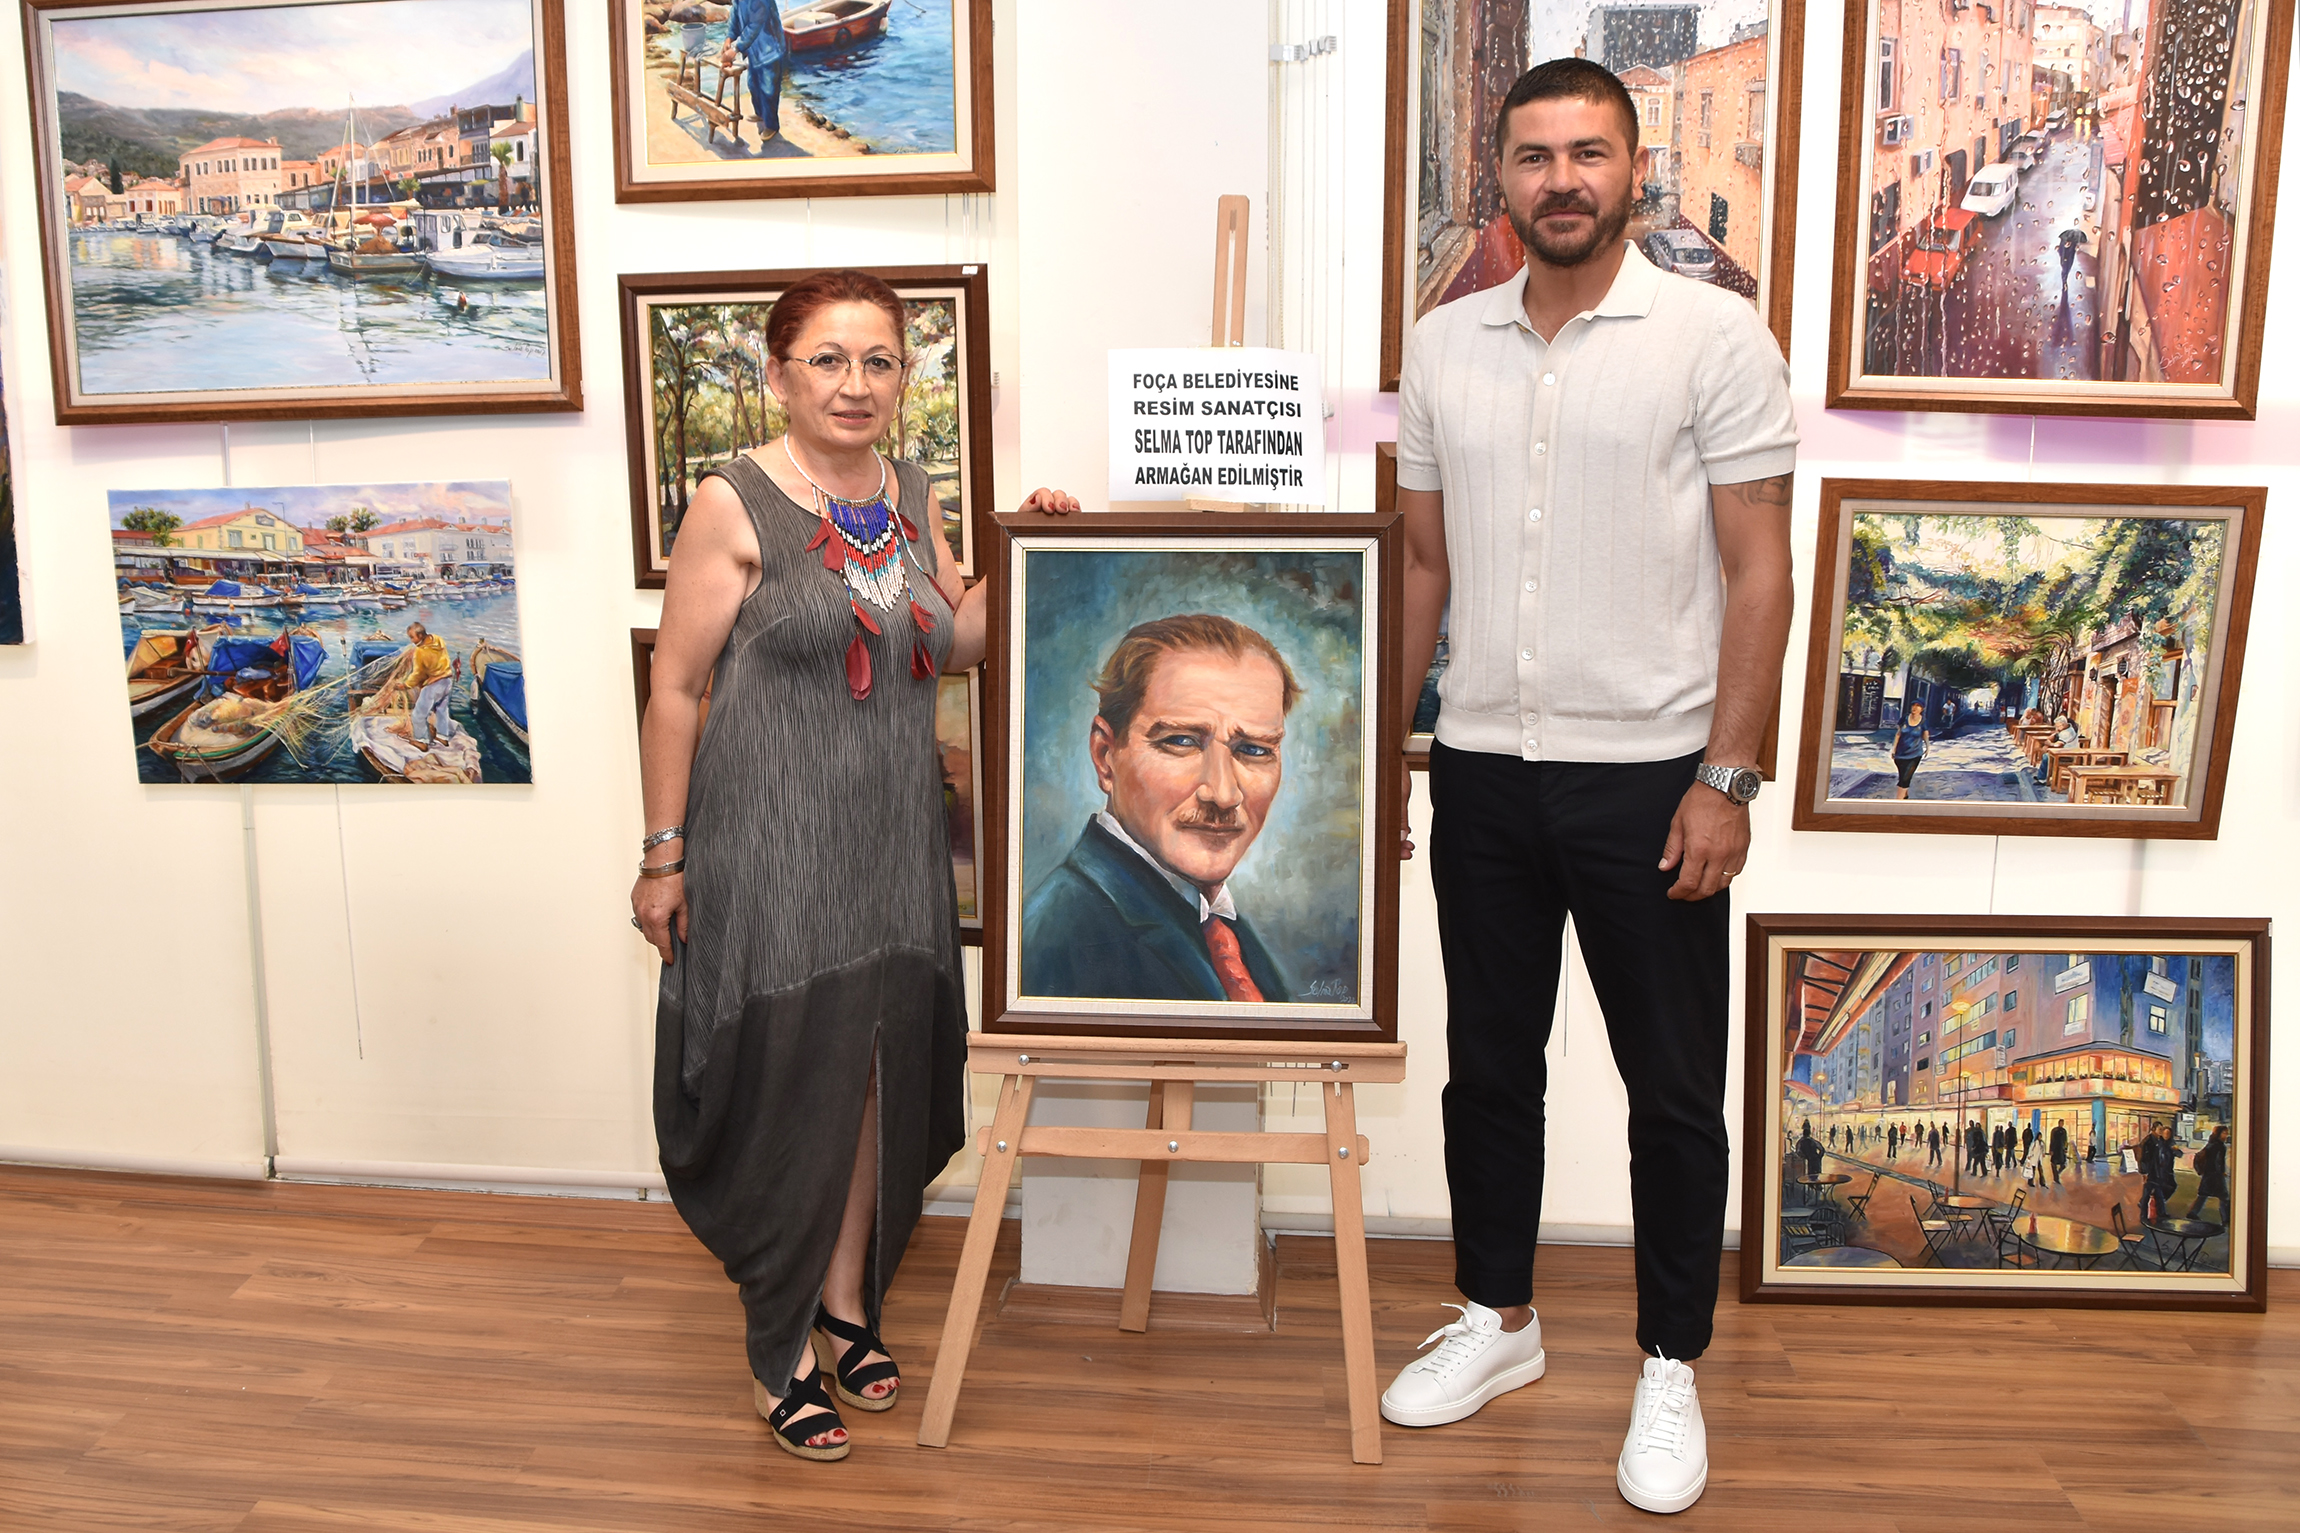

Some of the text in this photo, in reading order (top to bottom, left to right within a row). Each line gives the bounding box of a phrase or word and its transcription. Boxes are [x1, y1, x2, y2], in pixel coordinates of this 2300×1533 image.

[1133, 369, 1299, 393] FOÇA BELEDİYESİNE
[1133, 397, 1302, 420] RESİM SANATÇISI
[1134, 428, 1303, 456] SELMA TOP TARAFINDAN
[1135, 463, 1303, 490] ARMAĞAN EDİLMİŞTİR
